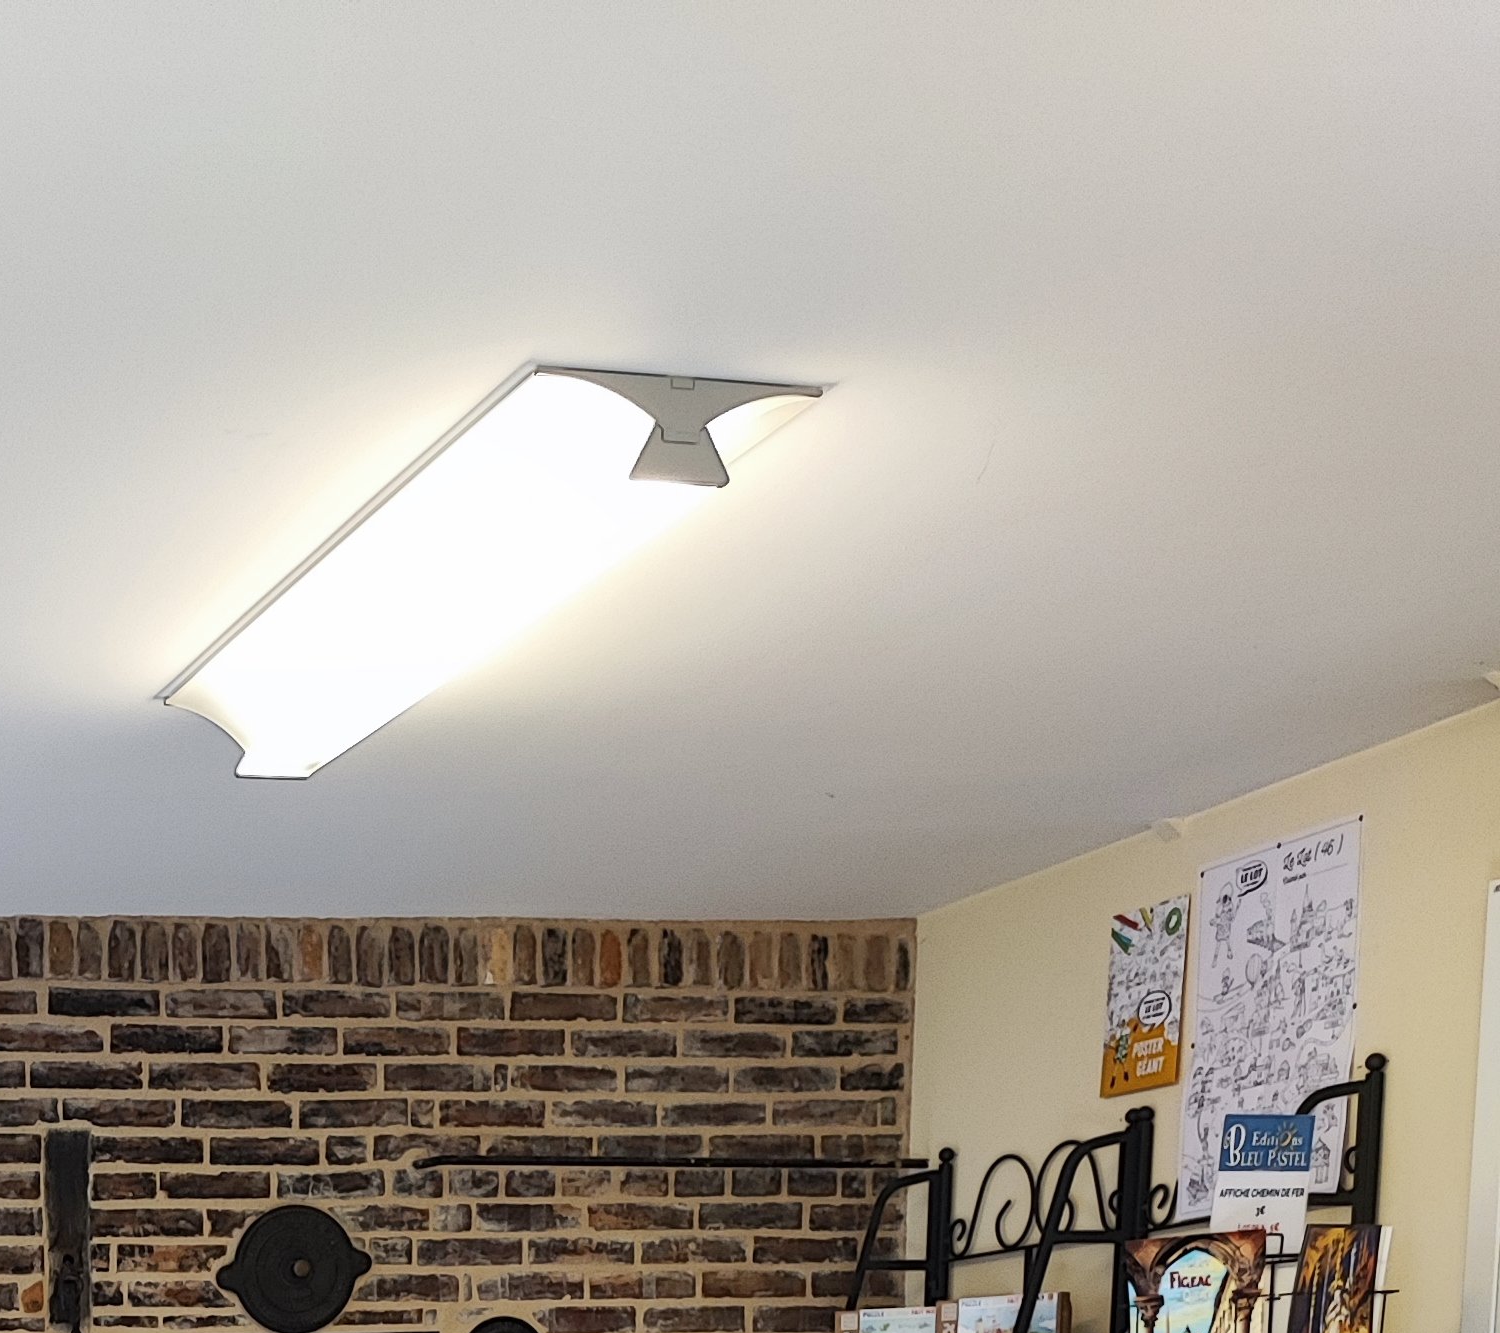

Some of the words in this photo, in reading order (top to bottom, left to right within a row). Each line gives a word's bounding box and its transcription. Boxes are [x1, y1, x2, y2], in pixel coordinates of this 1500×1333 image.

[1267, 1148, 1307, 1167] PASTEL
[1219, 1187, 1250, 1198] AFFICHE
[1251, 1187, 1280, 1198] CHEMIN
[1281, 1188, 1291, 1198] DE
[1292, 1187, 1305, 1198] FER
[1169, 1271, 1212, 1290] FIGEAC
